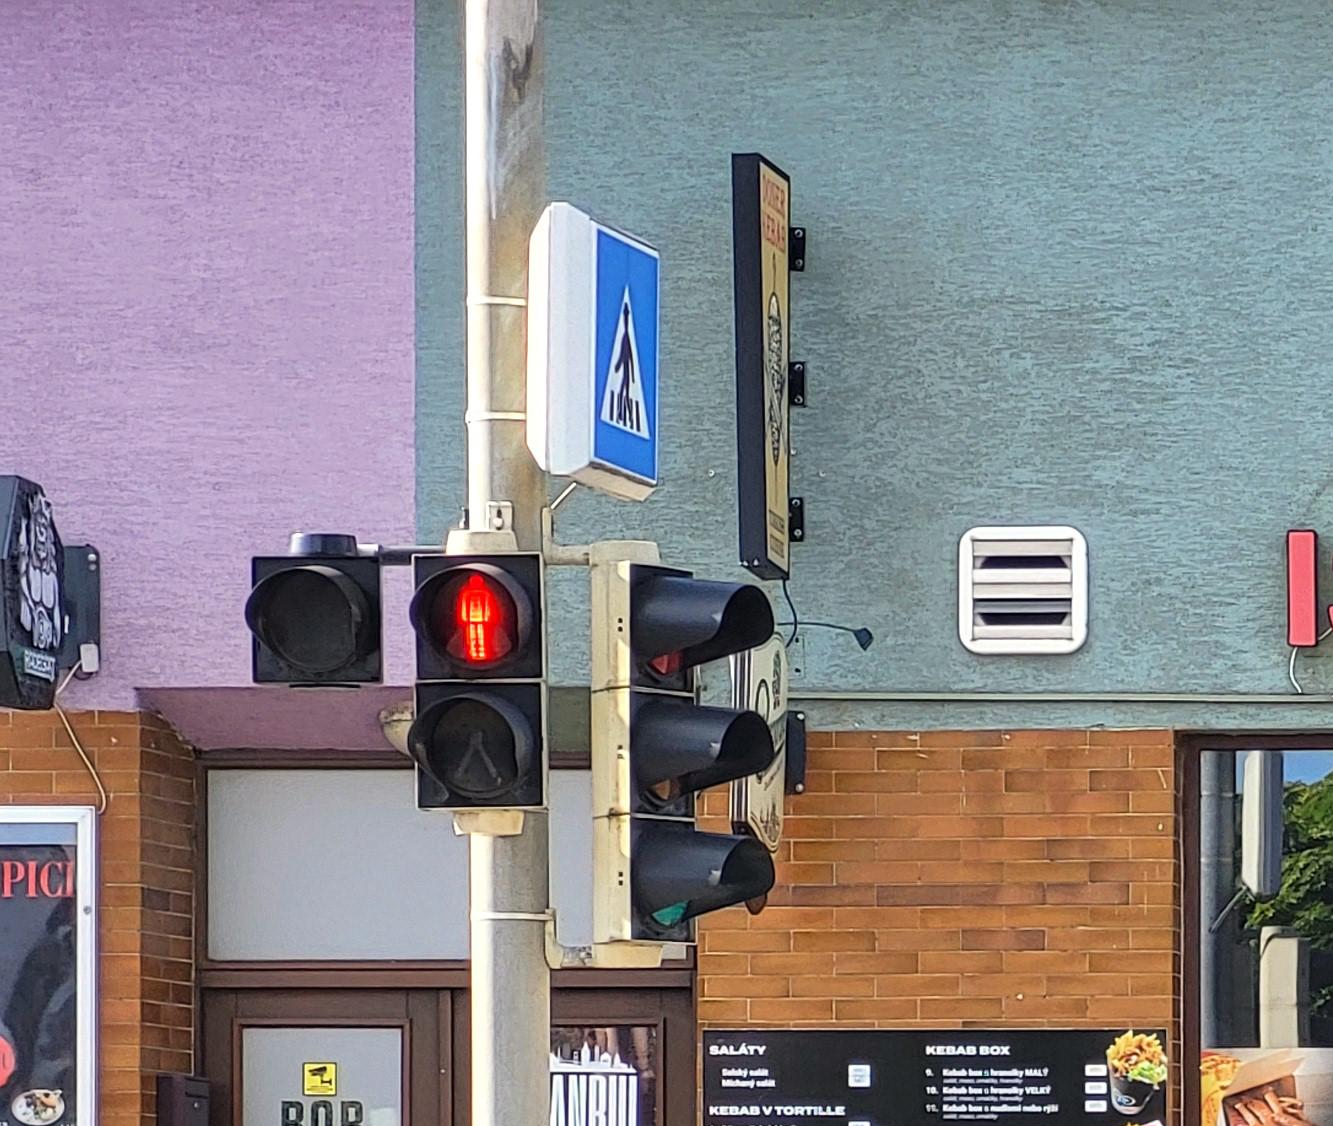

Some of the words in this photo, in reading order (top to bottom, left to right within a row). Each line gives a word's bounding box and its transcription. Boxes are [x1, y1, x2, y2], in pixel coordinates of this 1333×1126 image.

[1, 860, 75, 898] PICI
[709, 1043, 766, 1055] SALÁTY
[925, 1045, 977, 1055] KEBAB
[979, 1045, 1011, 1055] BOX
[709, 1106, 760, 1116] KEBAB
[762, 1106, 772, 1116] V
[775, 1106, 846, 1116] TORTILLE
